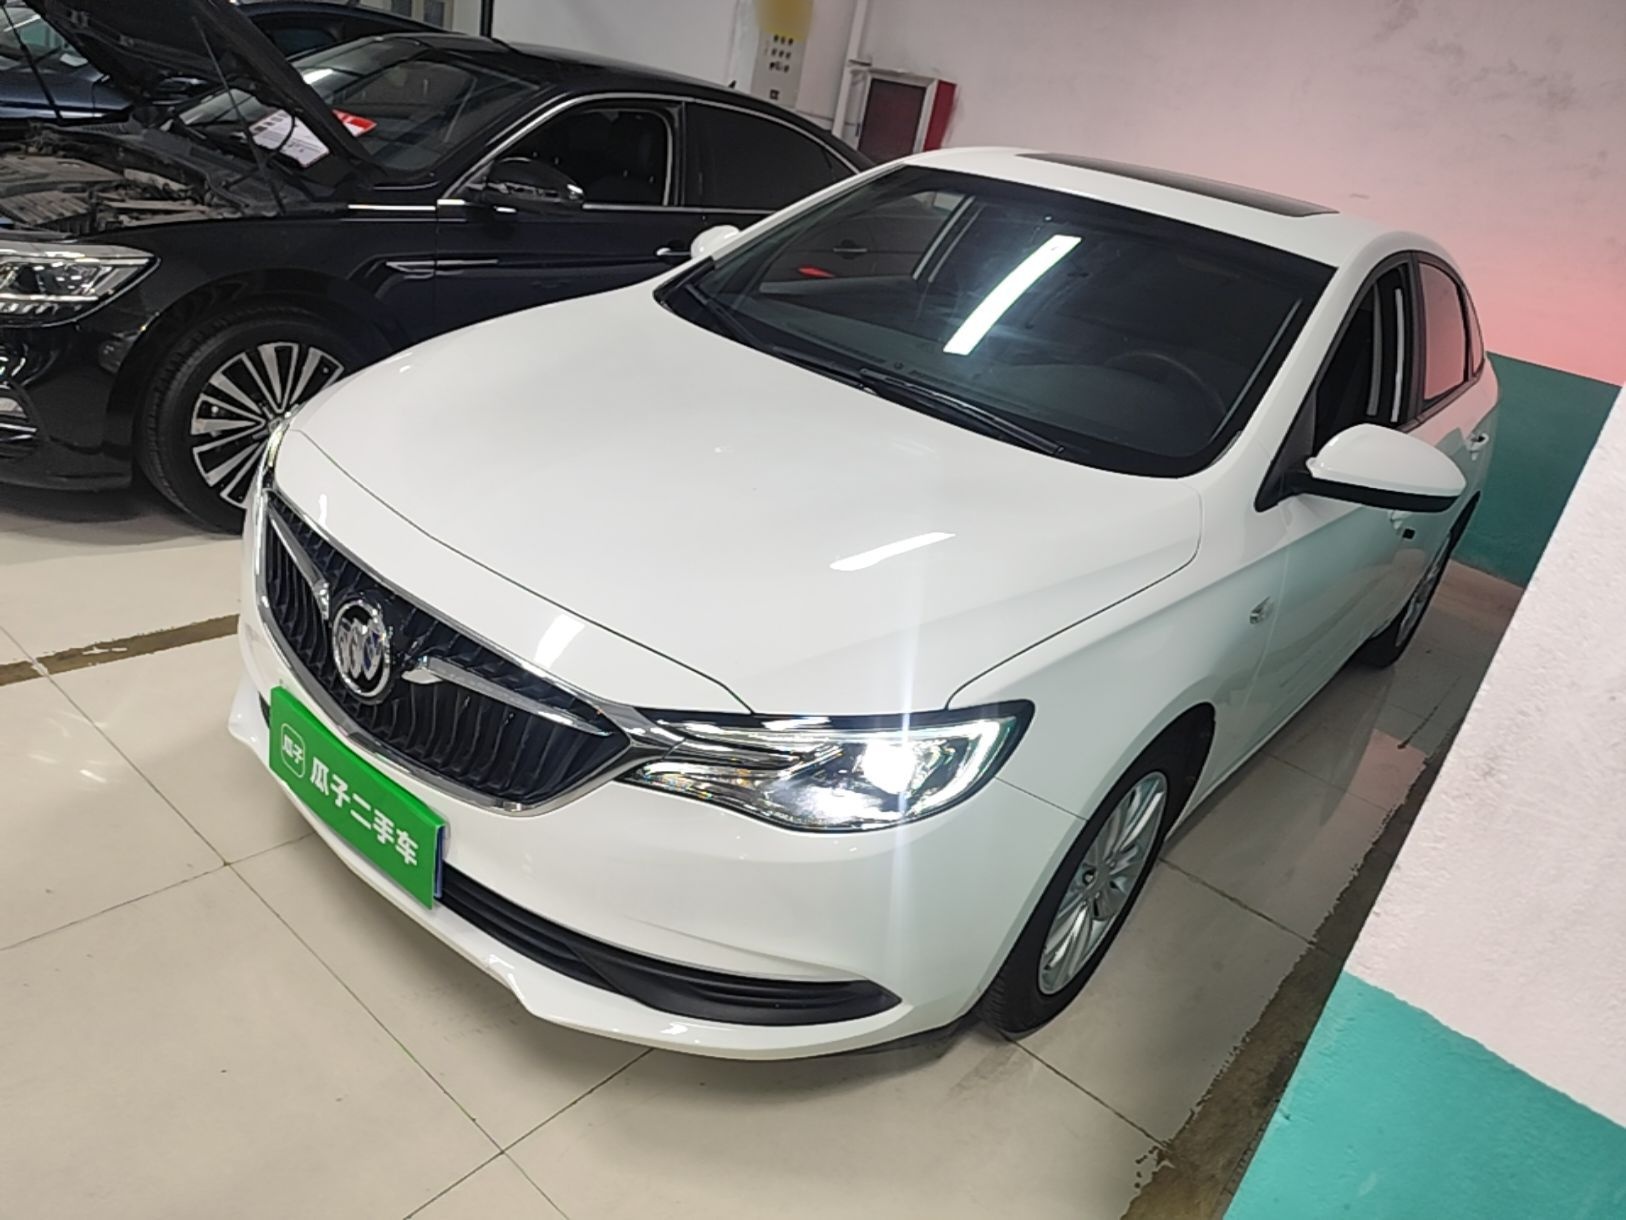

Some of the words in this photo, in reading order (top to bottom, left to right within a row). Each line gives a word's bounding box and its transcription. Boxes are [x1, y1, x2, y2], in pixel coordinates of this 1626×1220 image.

[282, 735, 304, 763] 瓜子
[310, 757, 419, 866] 瓜子二手车
